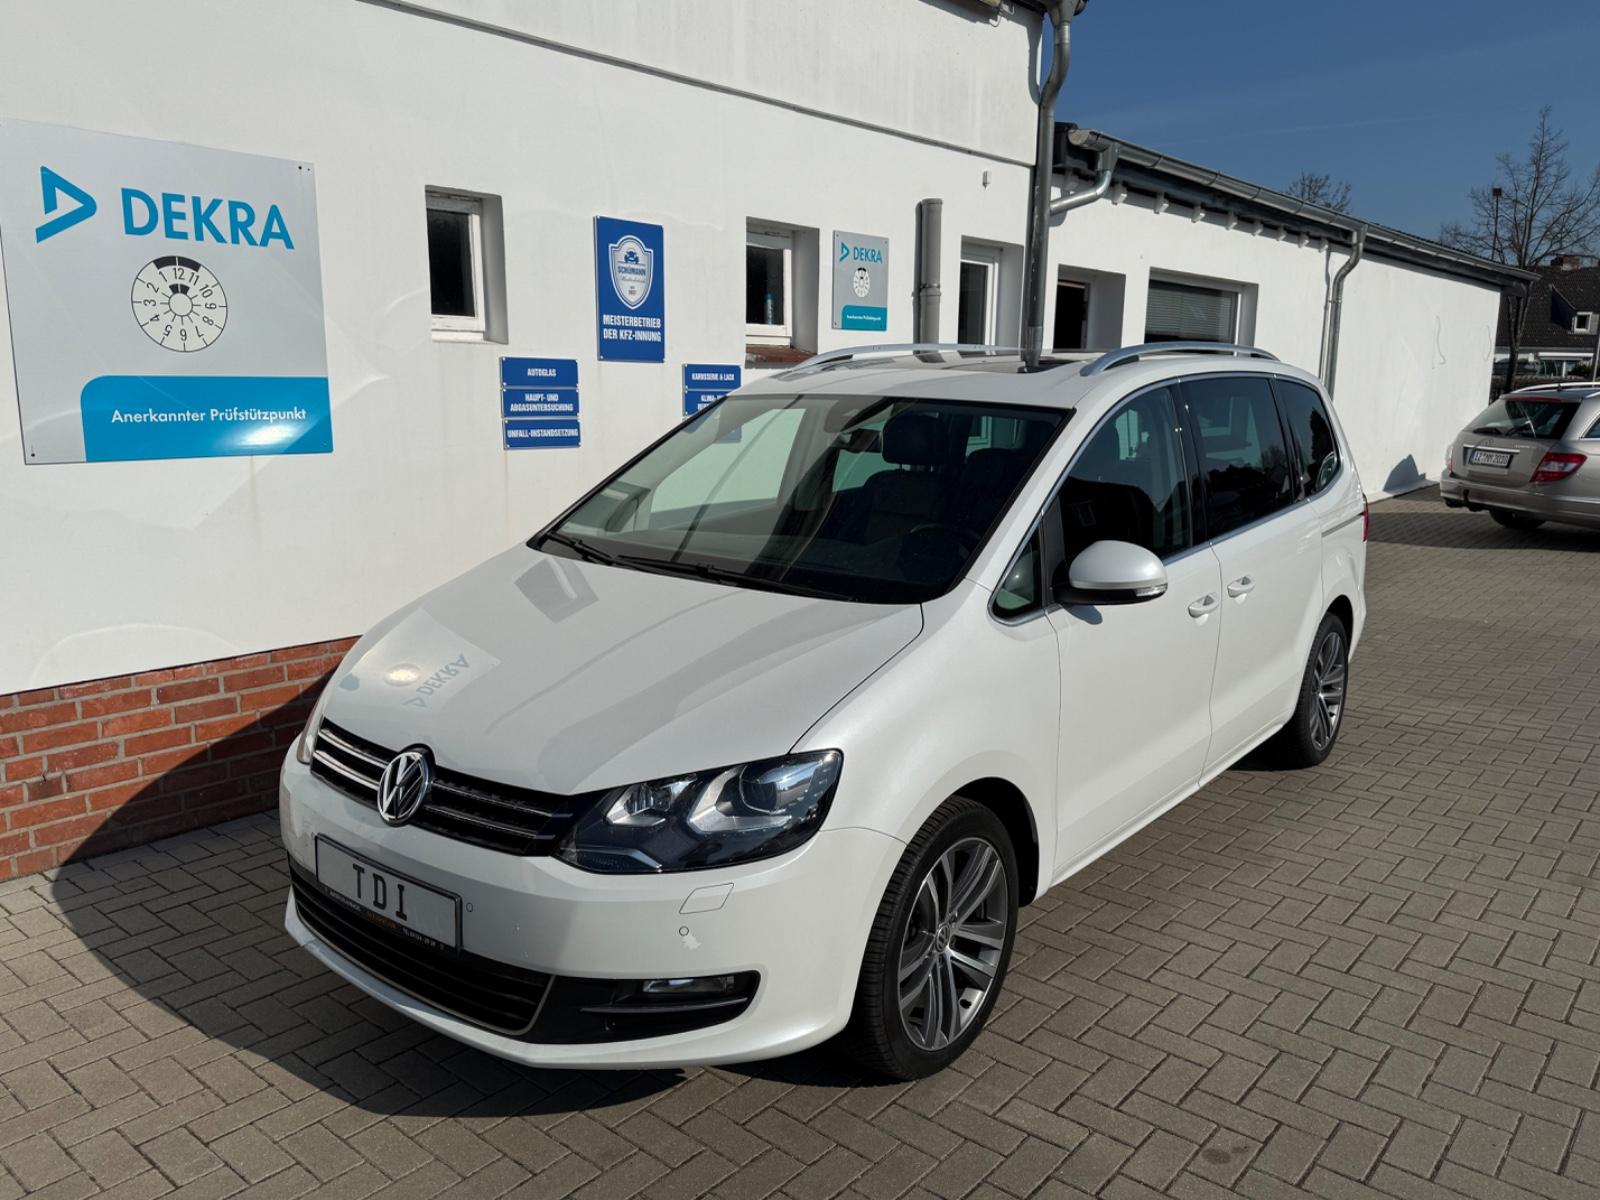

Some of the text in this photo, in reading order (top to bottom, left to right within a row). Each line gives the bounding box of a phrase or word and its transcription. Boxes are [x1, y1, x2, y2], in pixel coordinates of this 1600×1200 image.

[121, 187, 295, 250] DEKRA
[853, 246, 882, 264] DEKRA
[158, 270, 168, 283] 1
[172, 267, 186, 281] 12
[188, 271, 200, 286] 11
[146, 282, 160, 293] 2
[198, 283, 214, 299] 10
[143, 298, 157, 307] 3
[149, 313, 160, 322] 4
[202, 315, 214, 326] 8
[603, 314, 661, 329] MEISTERBETRIEB
[162, 324, 173, 337] 5
[603, 328, 662, 342] DER KFZ-INNUNG
[527, 368, 556, 377] AUTOGLAS
[525, 393, 559, 402] HAUPT- UND
[111, 407, 307, 425] Anerkannter Prüfstützpunkt
[507, 428, 579, 438] UNFALL-INSTANDSETZUNG
[352, 863, 408, 922] TDI
